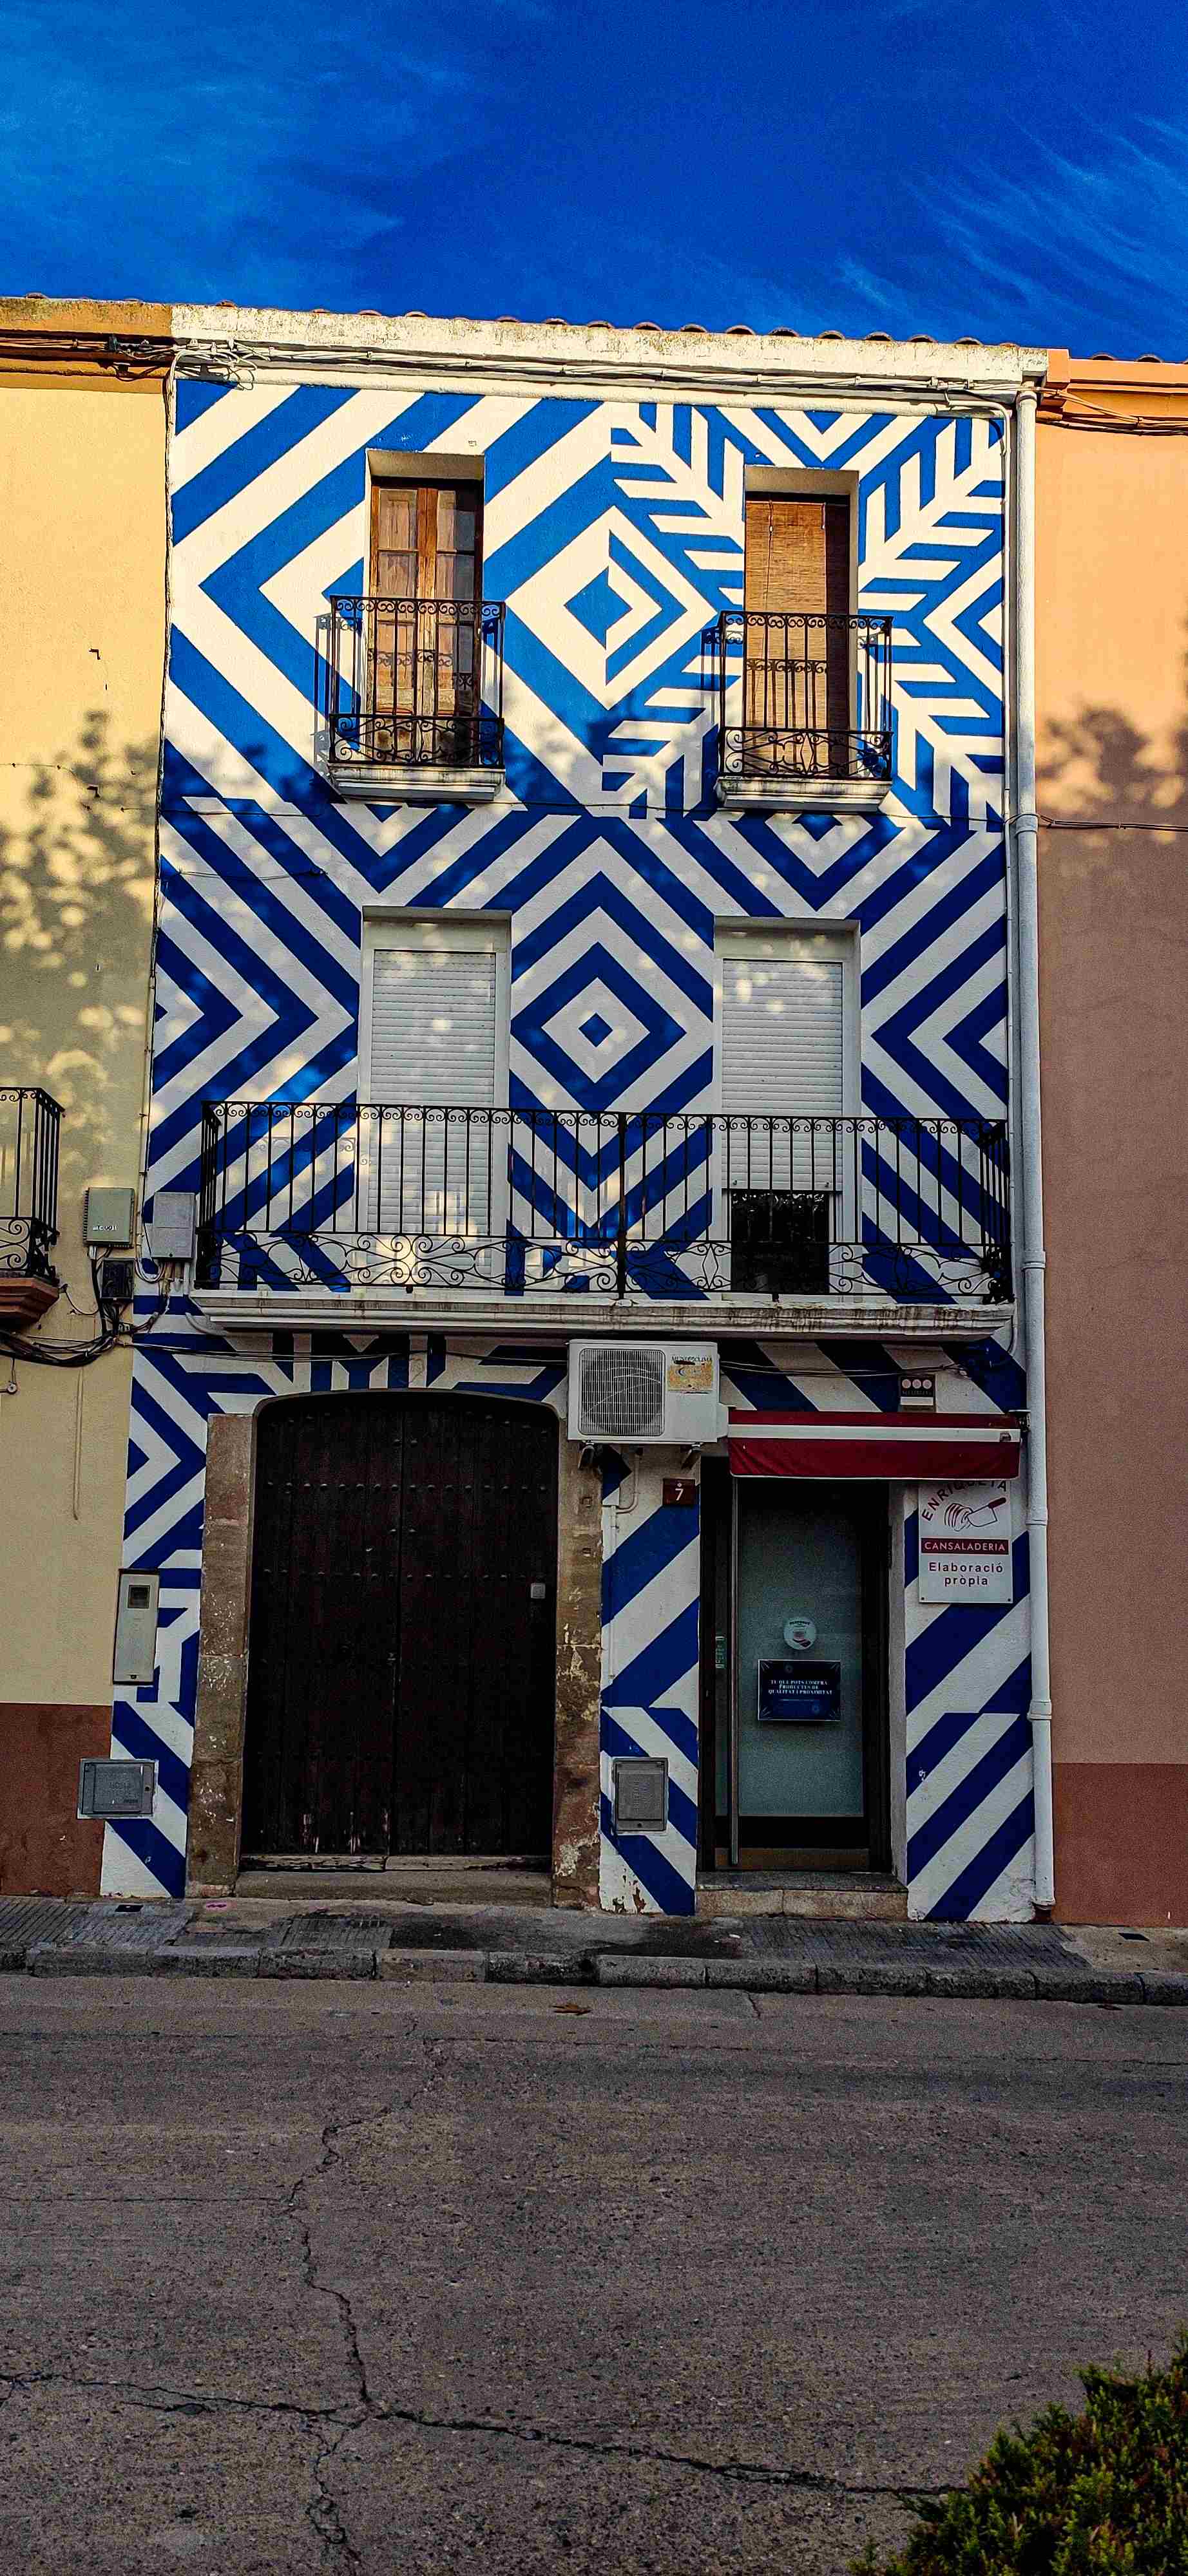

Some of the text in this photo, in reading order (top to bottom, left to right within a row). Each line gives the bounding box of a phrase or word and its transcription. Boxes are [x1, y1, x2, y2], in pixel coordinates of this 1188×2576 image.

[675, 1488, 684, 1501] 7
[921, 1481, 1006, 1521] ENRIQA
[925, 1542, 1006, 1551] CANSALADERIA
[929, 1562, 1003, 1573] Elaboració
[944, 1575, 988, 1587] pròpia
